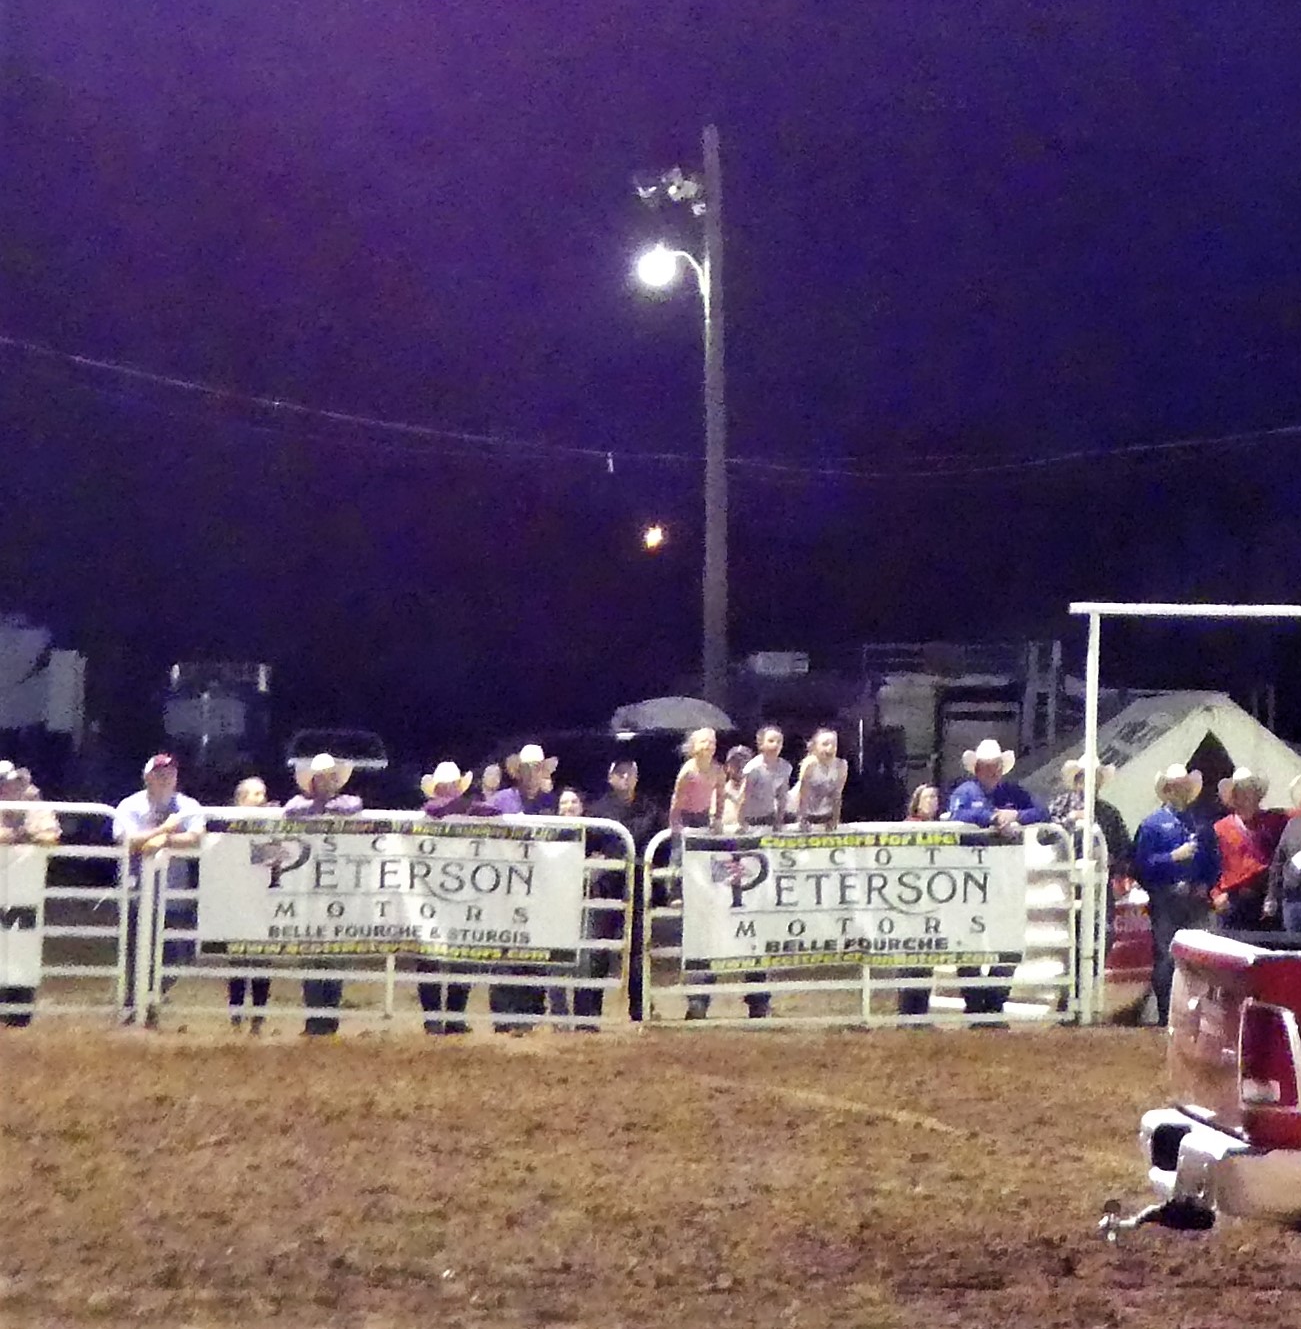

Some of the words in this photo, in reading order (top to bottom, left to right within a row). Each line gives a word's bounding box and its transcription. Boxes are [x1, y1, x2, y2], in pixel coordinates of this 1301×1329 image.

[323, 836, 537, 860] SCOTT
[777, 848, 988, 868] SCOTT
[249, 837, 537, 897] PETERSON
[710, 851, 990, 910] PETERSON
[273, 901, 531, 925] MOTORS
[267, 924, 329, 939] BELLE
[447, 928, 532, 945] STURGIS
[734, 914, 988, 939] MOTORS
[763, 938, 840, 954] BELLE
